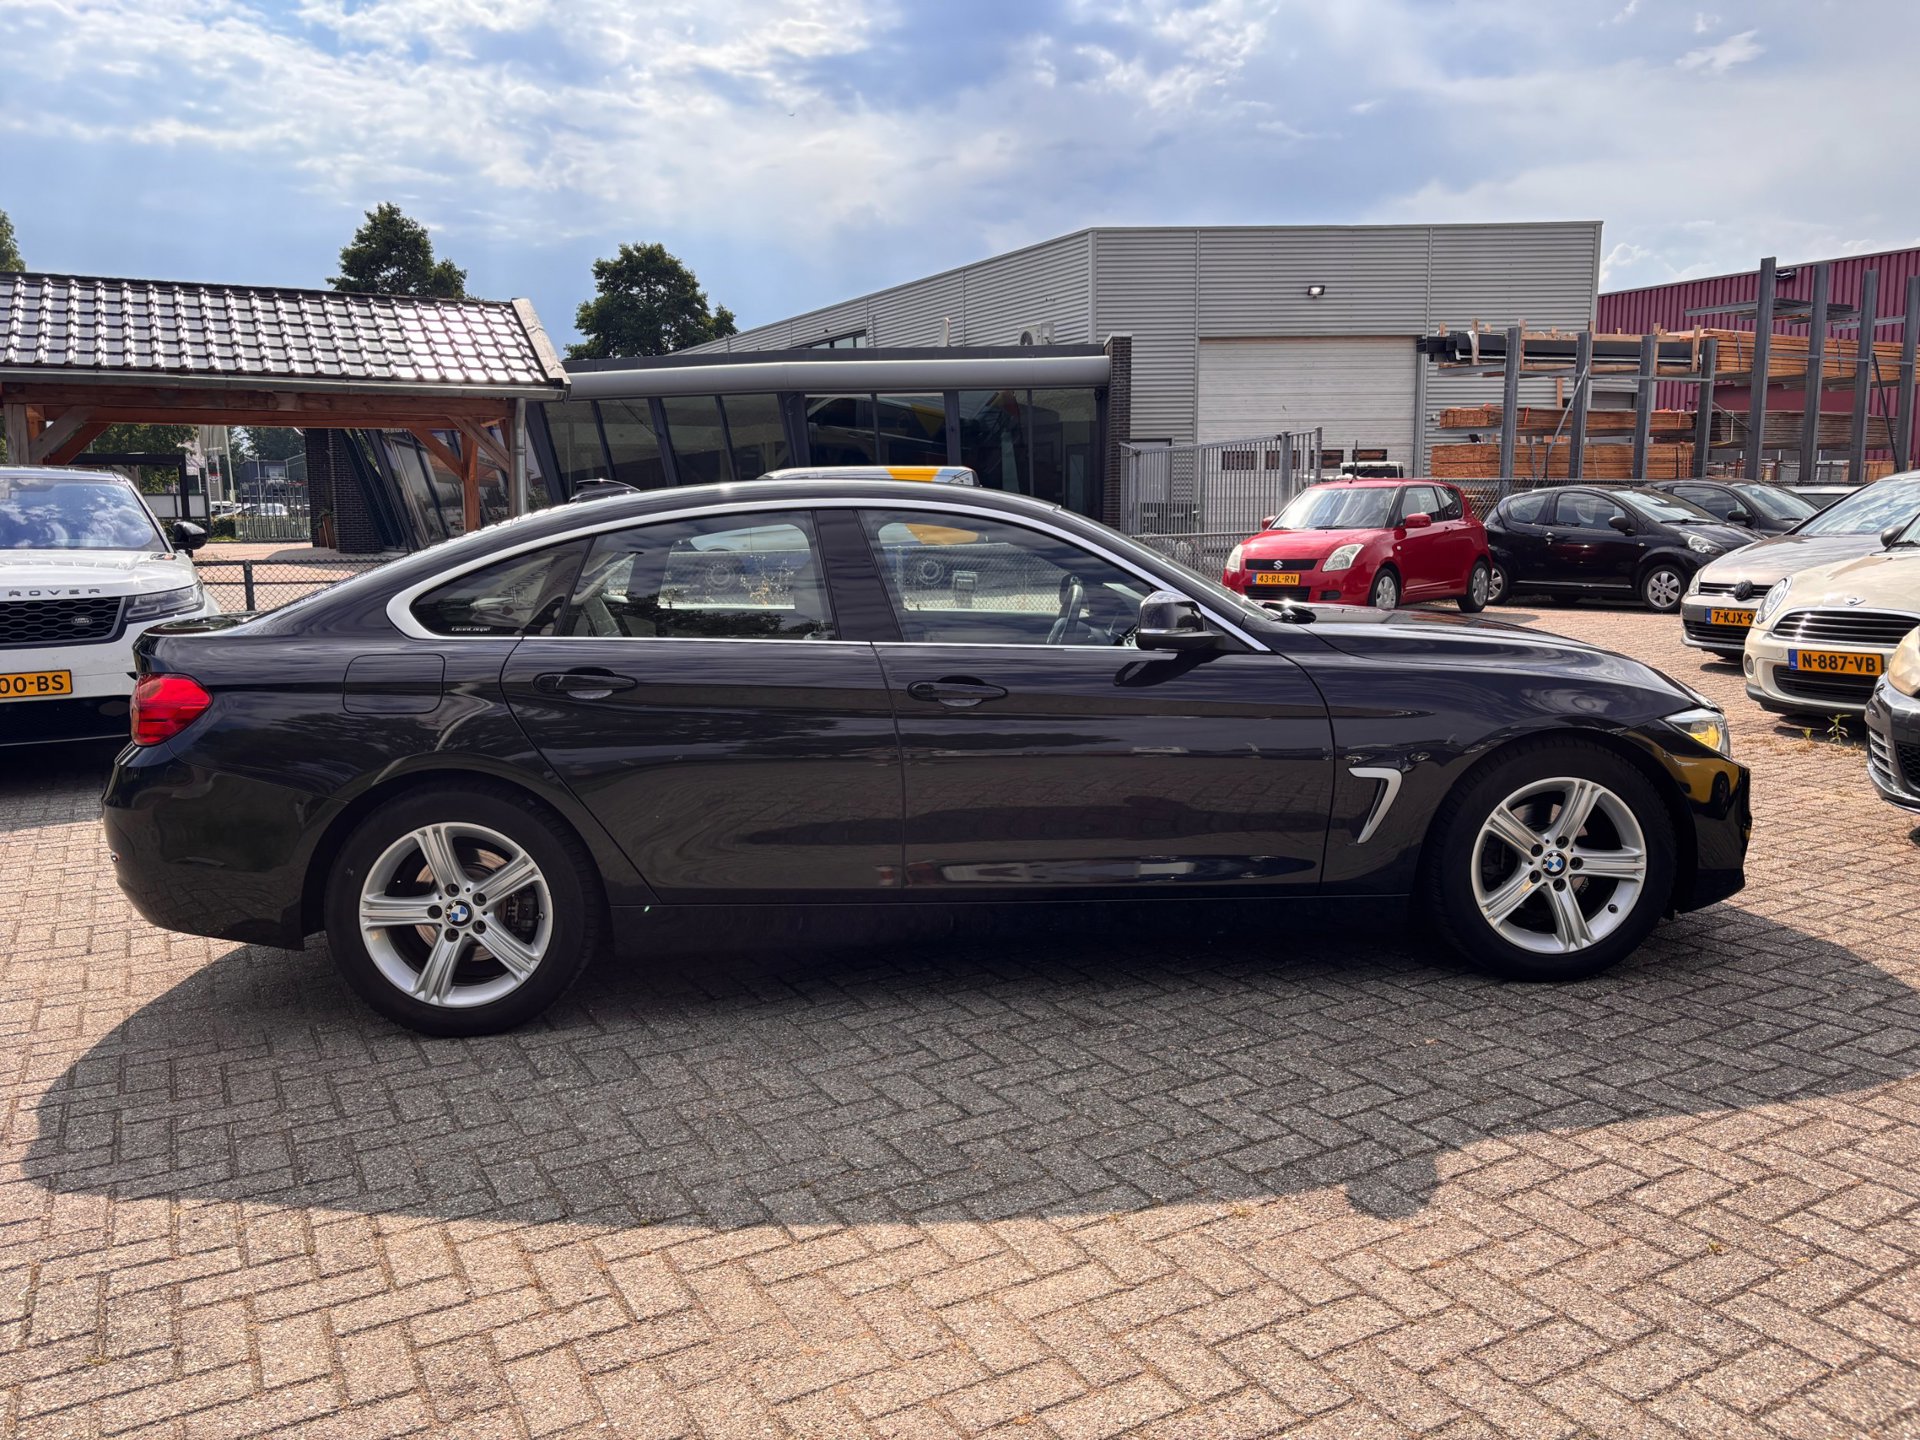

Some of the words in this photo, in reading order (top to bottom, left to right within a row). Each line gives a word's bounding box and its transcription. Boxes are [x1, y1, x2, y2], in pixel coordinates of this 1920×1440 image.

[1258, 575, 1297, 584] 43-RL-RN
[8, 588, 101, 597] ROVER
[1714, 611, 1754, 625] 7-KJX-9
[1802, 653, 1876, 673] N-887-VB
